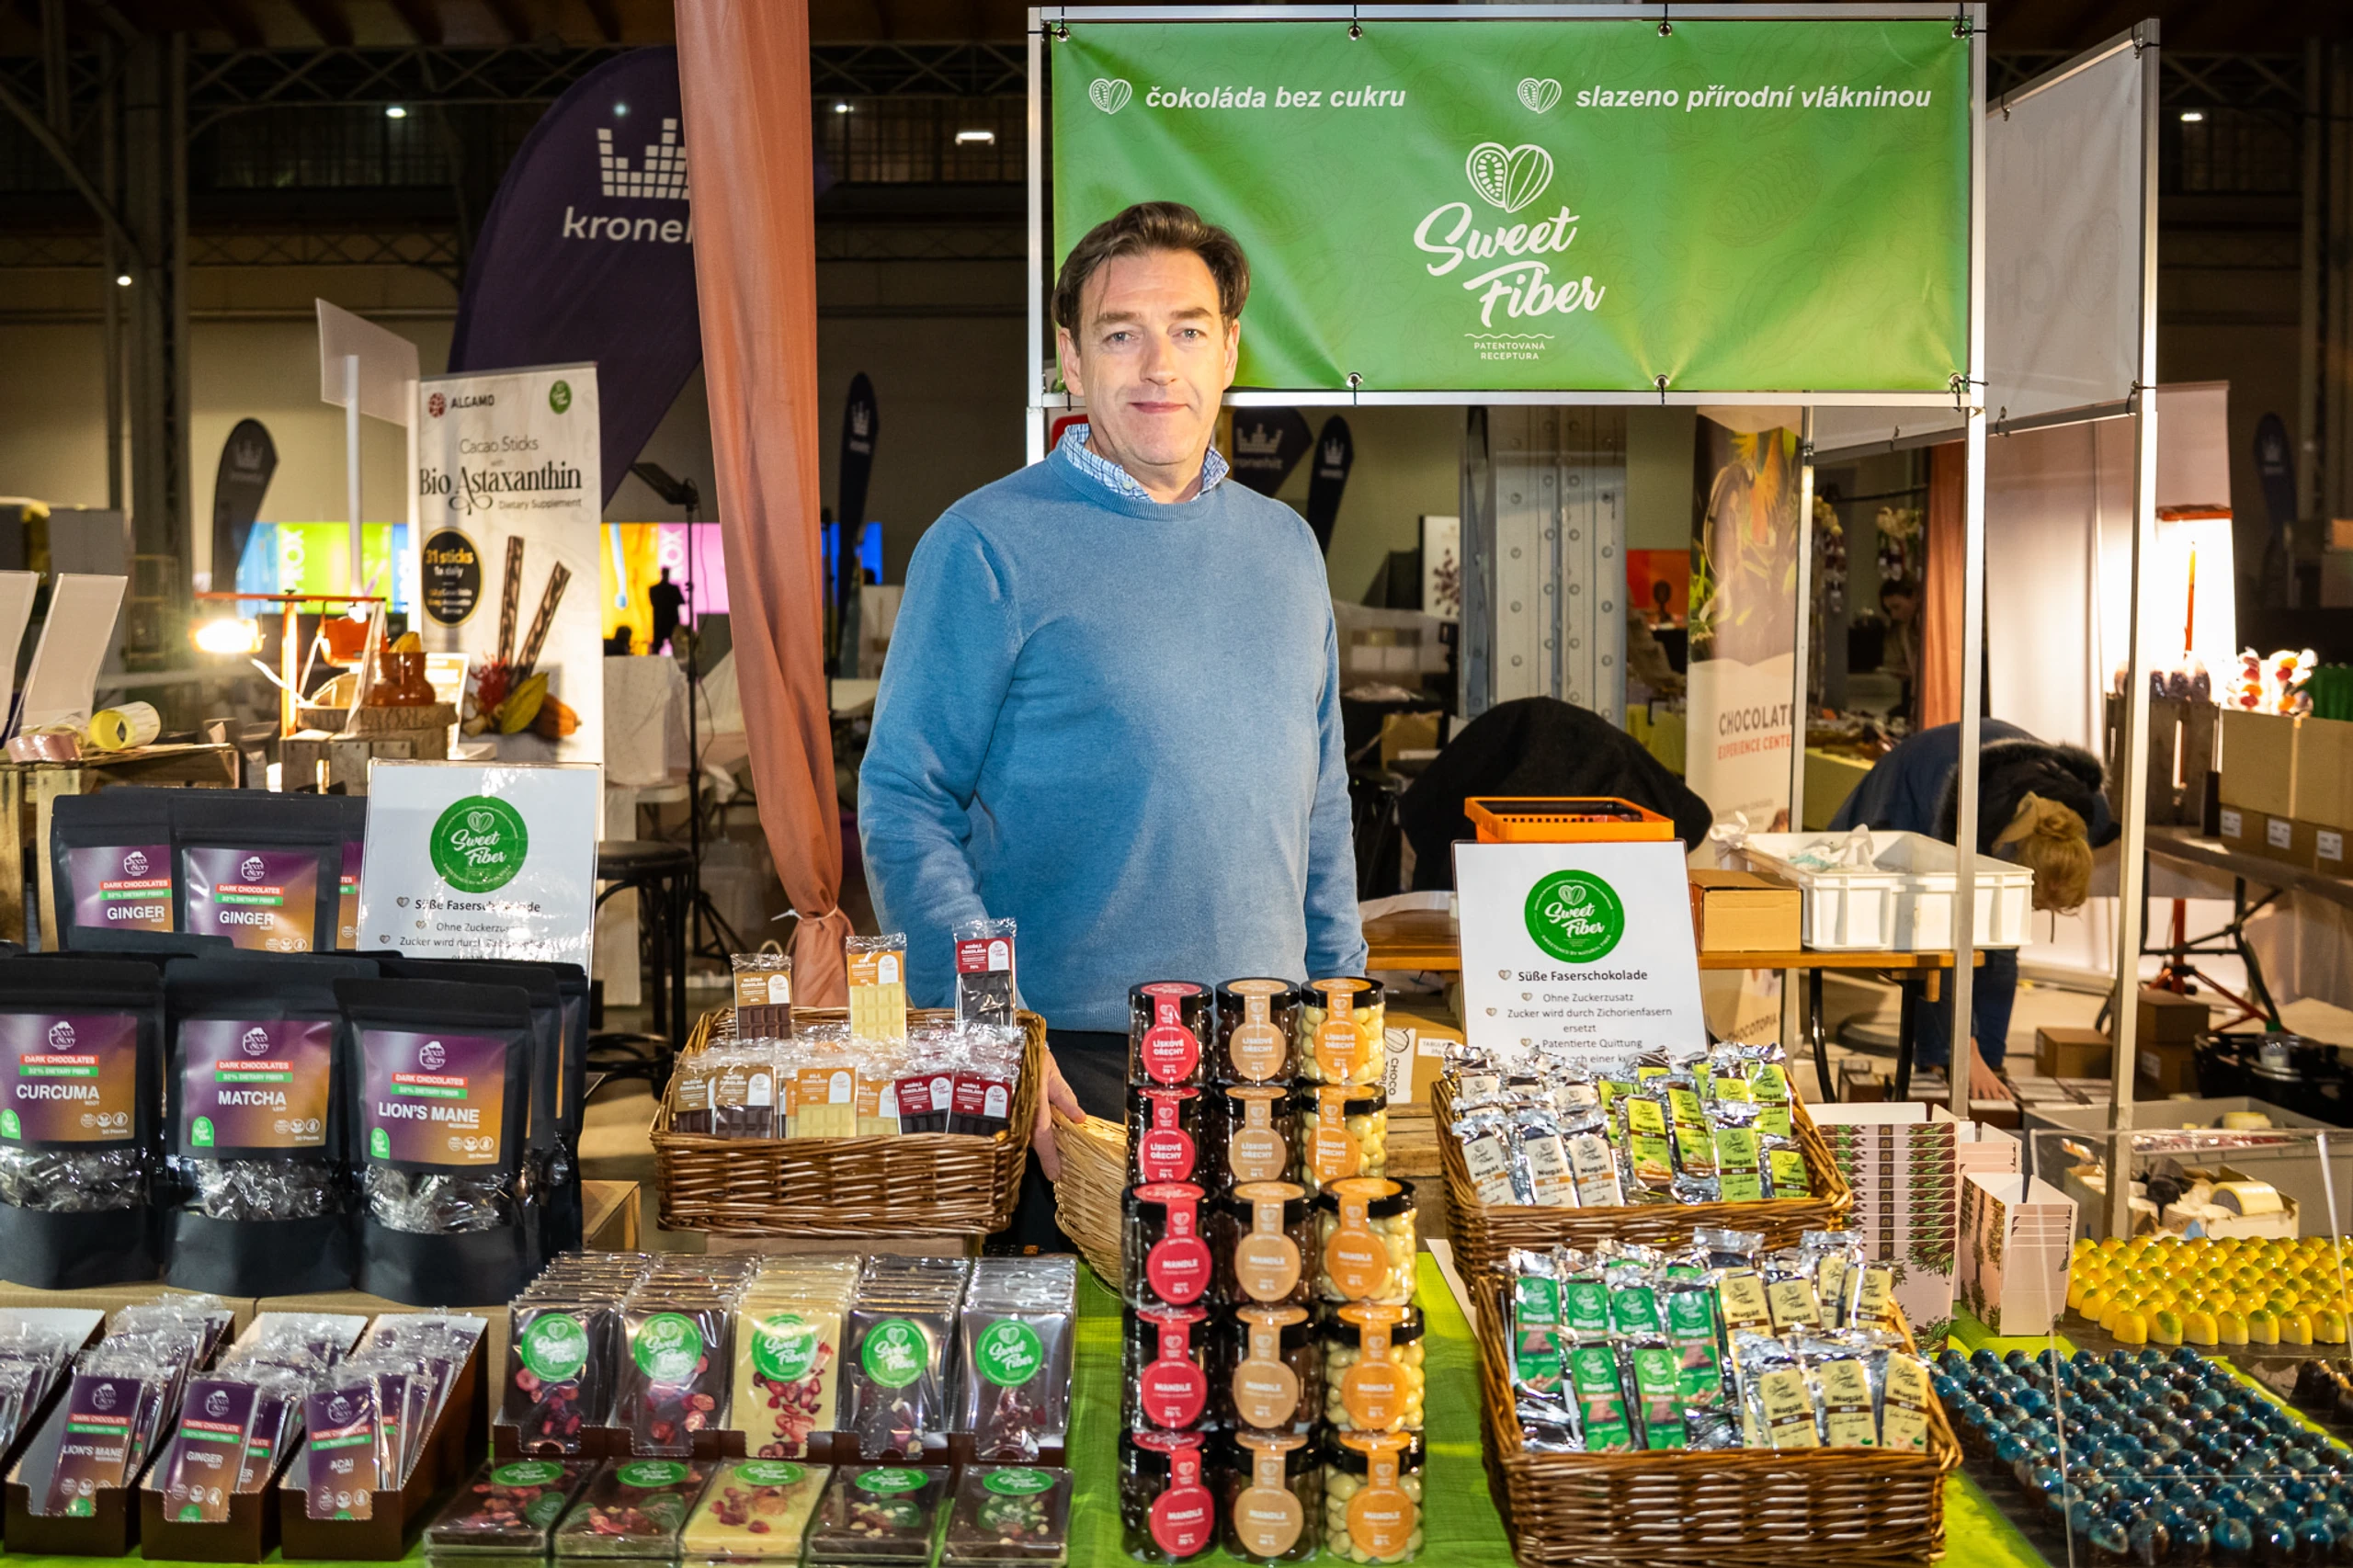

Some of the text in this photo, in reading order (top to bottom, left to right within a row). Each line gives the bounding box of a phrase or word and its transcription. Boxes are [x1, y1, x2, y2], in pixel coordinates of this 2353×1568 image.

[1145, 82, 1406, 108] čokoláda bez cukru
[1575, 84, 1932, 112] slazeno přírodní vlákninou
[1414, 202, 1580, 276] Sweet
[1462, 261, 1606, 328] Fiber
[1473, 341, 1546, 350] PATENTOVANÁ
[1481, 351, 1540, 360] RECEPTURA
[460, 436, 540, 455] Cacao Sticks
[419, 460, 583, 516] Bio Astaxanthin
[1763, 733, 1791, 751] CENTE
[450, 829, 501, 851] Sweet
[464, 846, 506, 867] Fiber
[103, 880, 168, 890] DARK CHOCOLATES
[220, 885, 280, 894] DARK CHOCOLATES
[107, 905, 165, 921] GINGER
[219, 911, 275, 926] GINGER
[1544, 902, 1596, 924] Sweet
[436, 922, 517, 933] Ohne Zuckerzus
[1561, 917, 1605, 938] Fiber
[399, 937, 431, 947] Zucker
[1518, 970, 1648, 982] Süße Faserschokolade
[1542, 993, 1634, 1003] Ohne Zuckerzusatz
[1507, 1006, 1673, 1018] Zucker wird durch Zichorienfasern
[1563, 1024, 1597, 1033] ersetzt
[1542, 1038, 1643, 1050] Patentierte Quittung
[24, 1054, 96, 1064] DARK CHOCOLATES
[219, 1062, 290, 1070] DARK CHOCOLATES
[1589, 1055, 1615, 1063] einer
[395, 1074, 464, 1086] DARK CHOCOLATES
[1388, 1058, 1400, 1096] CHOCO
[16, 1084, 100, 1099] CURCUMA
[218, 1090, 287, 1106] MATCHA
[378, 1101, 480, 1123] LION'S MANE
[62, 1444, 124, 1457] LION'S MANE
[186, 1450, 224, 1464] GINGER
